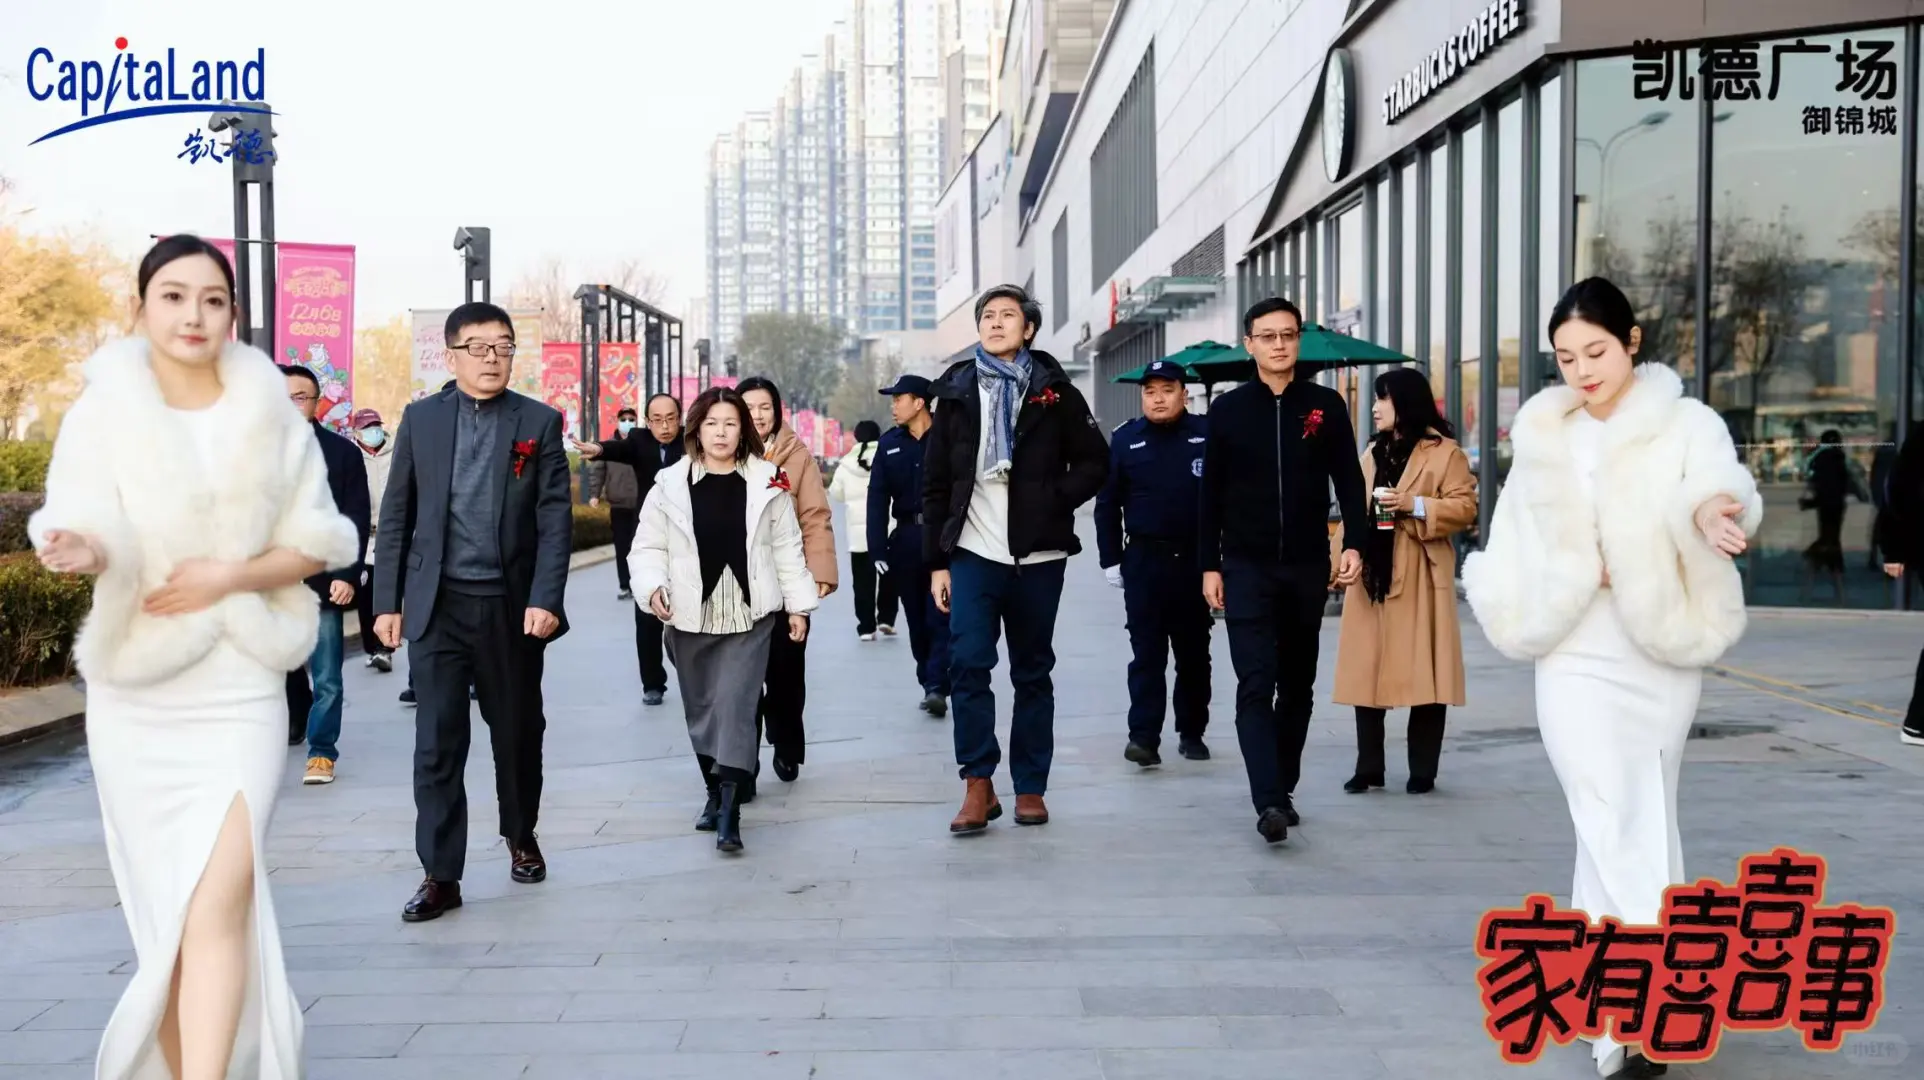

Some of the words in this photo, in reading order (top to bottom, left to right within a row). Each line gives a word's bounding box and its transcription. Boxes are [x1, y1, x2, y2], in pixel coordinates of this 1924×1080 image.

[1382, 35, 1456, 125] STARBUCKS
[1458, 0, 1519, 67] COFFEE
[288, 303, 342, 322] 12月6日
